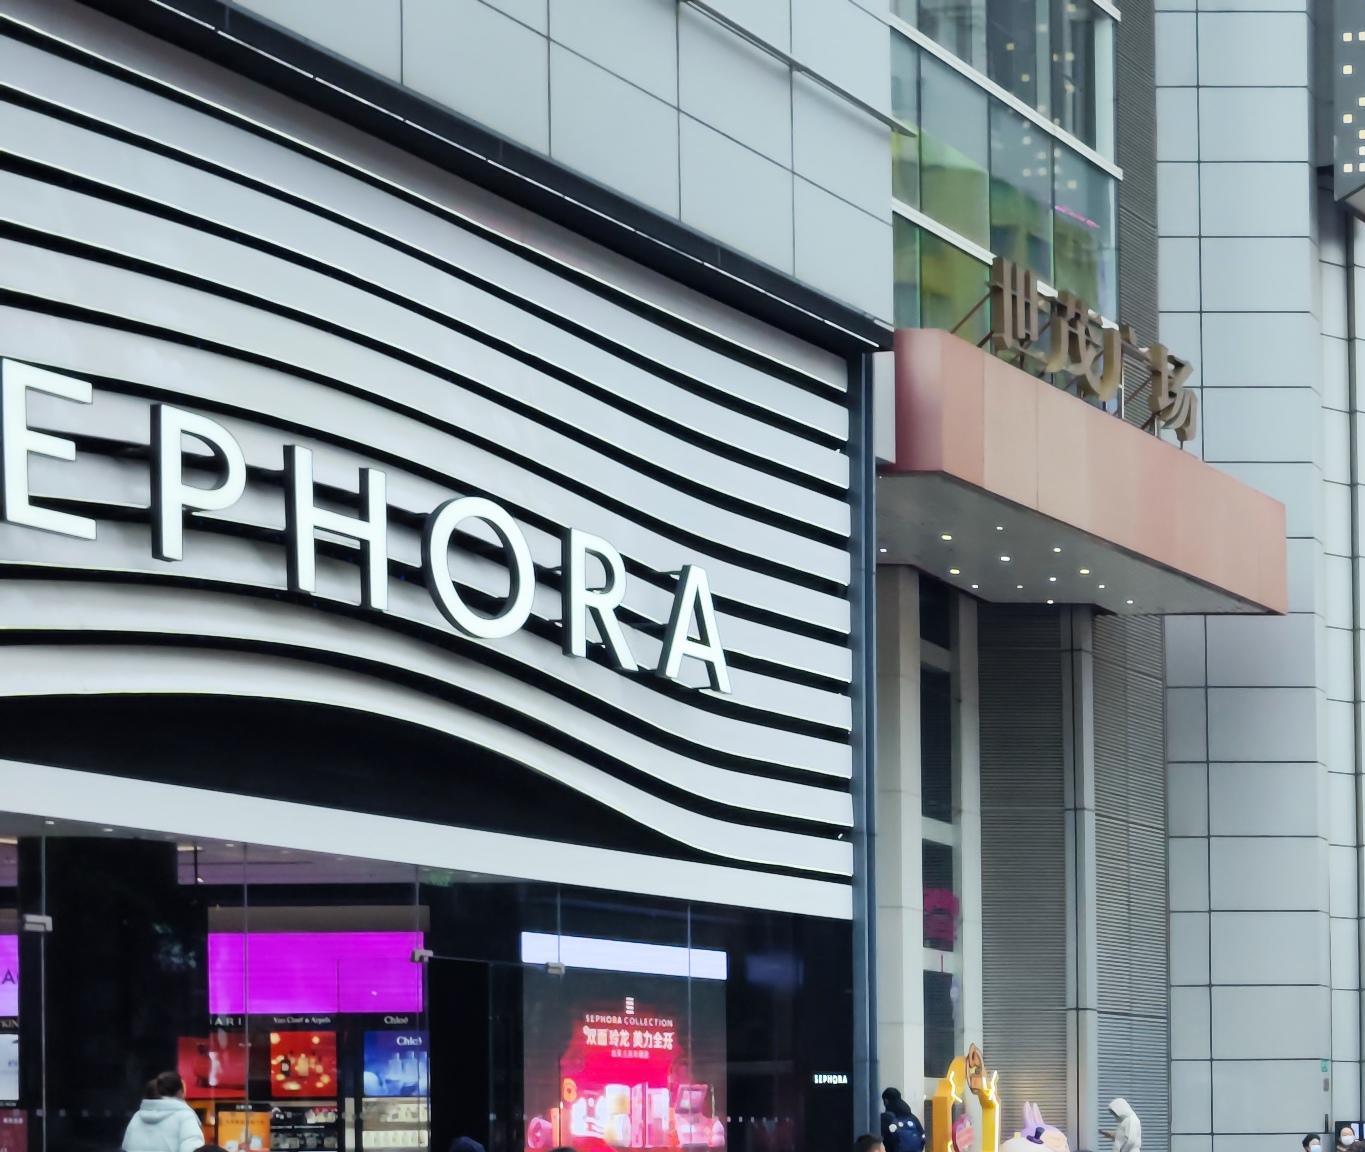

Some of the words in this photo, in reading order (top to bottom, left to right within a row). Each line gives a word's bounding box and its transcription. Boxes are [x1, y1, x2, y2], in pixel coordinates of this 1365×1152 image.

[585, 1014, 622, 1024] SEPHORA
[623, 1016, 674, 1028] COLLECTION
[814, 1074, 848, 1084] SEPHORA
